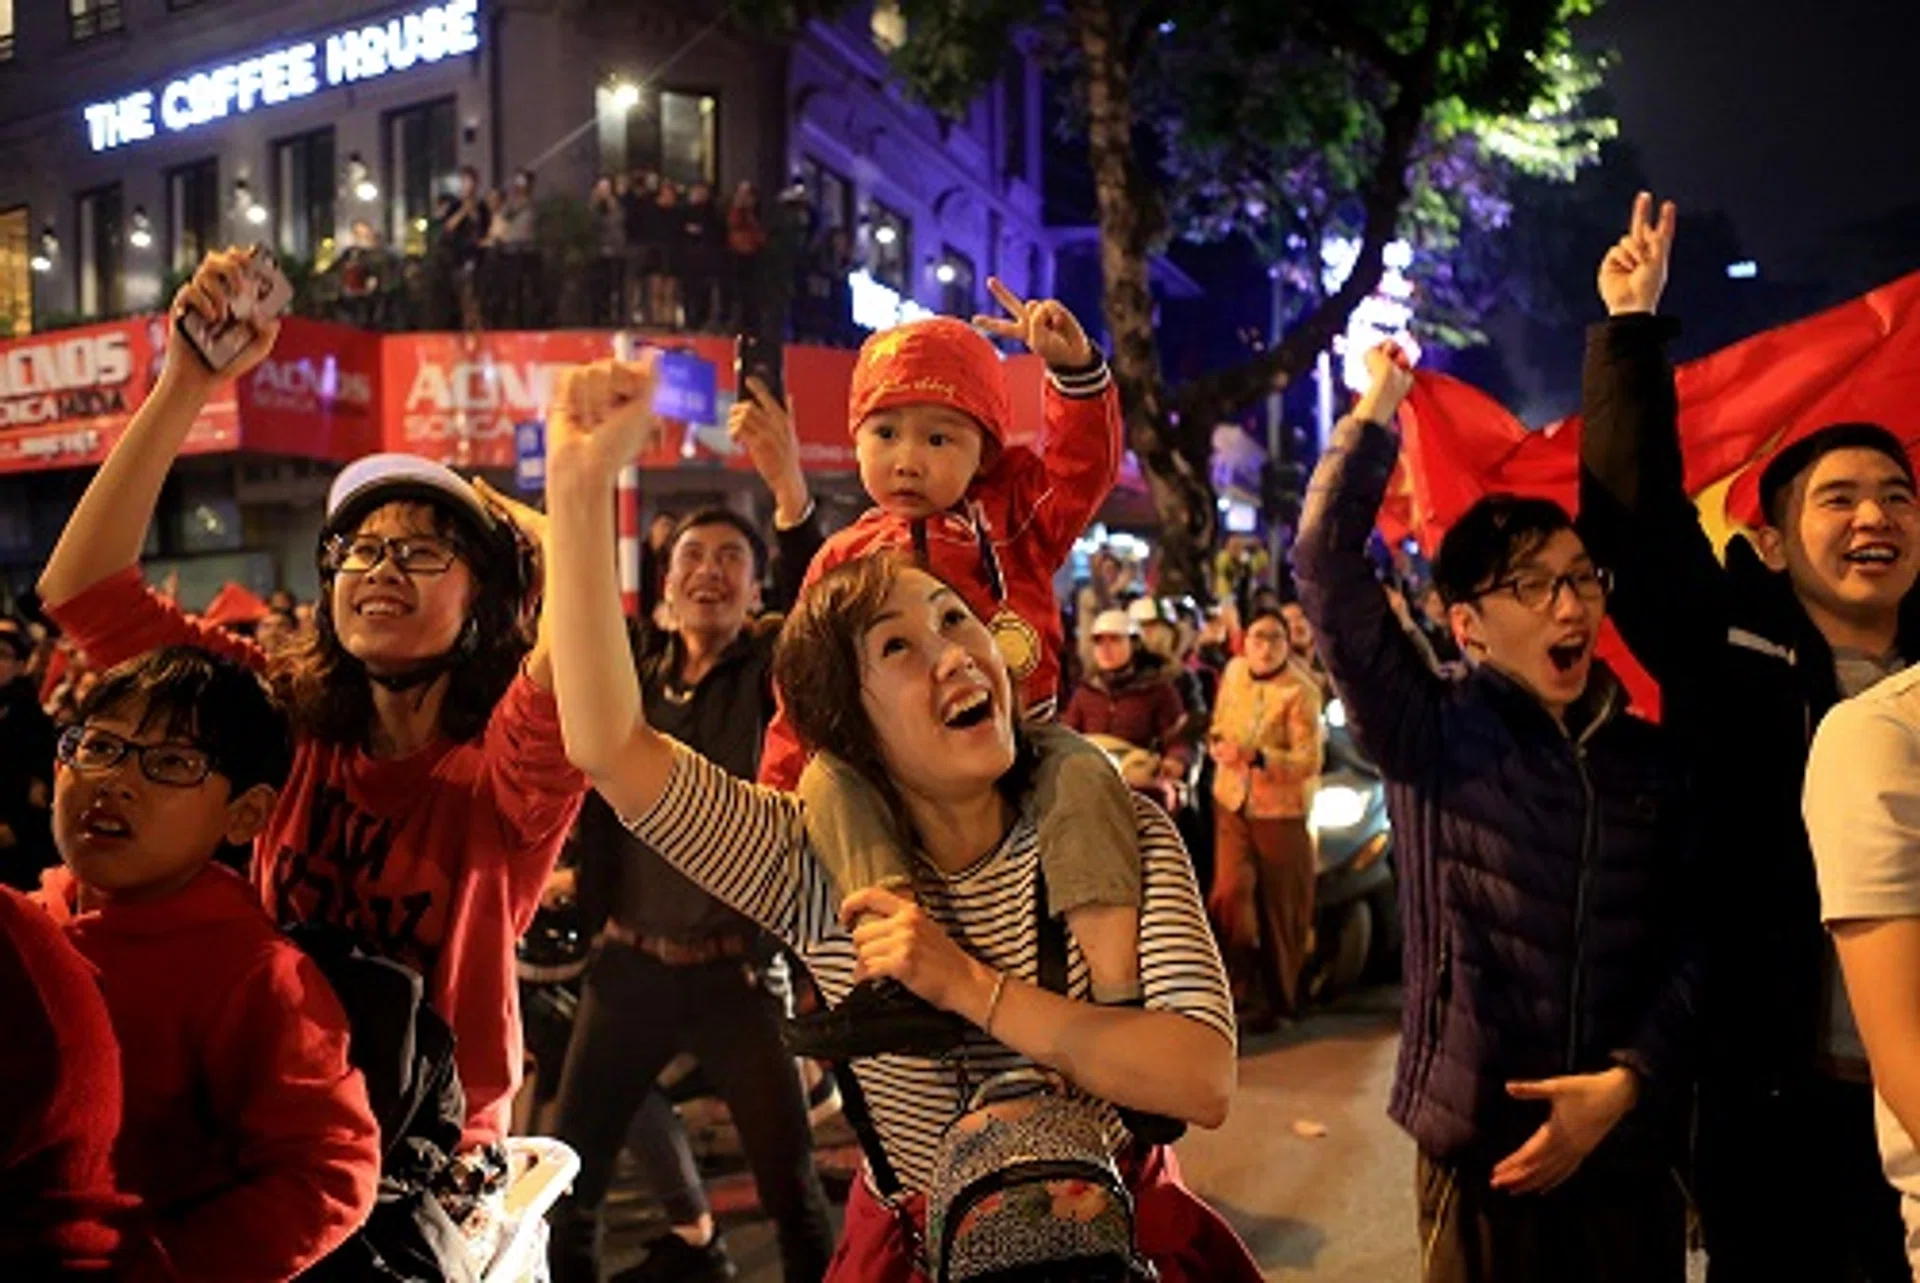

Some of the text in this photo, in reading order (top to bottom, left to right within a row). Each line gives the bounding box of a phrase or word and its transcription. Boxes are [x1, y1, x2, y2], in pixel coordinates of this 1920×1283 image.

[84, 1, 478, 151] THE COFFEE HOUSE
[0, 332, 130, 397] CNOS
